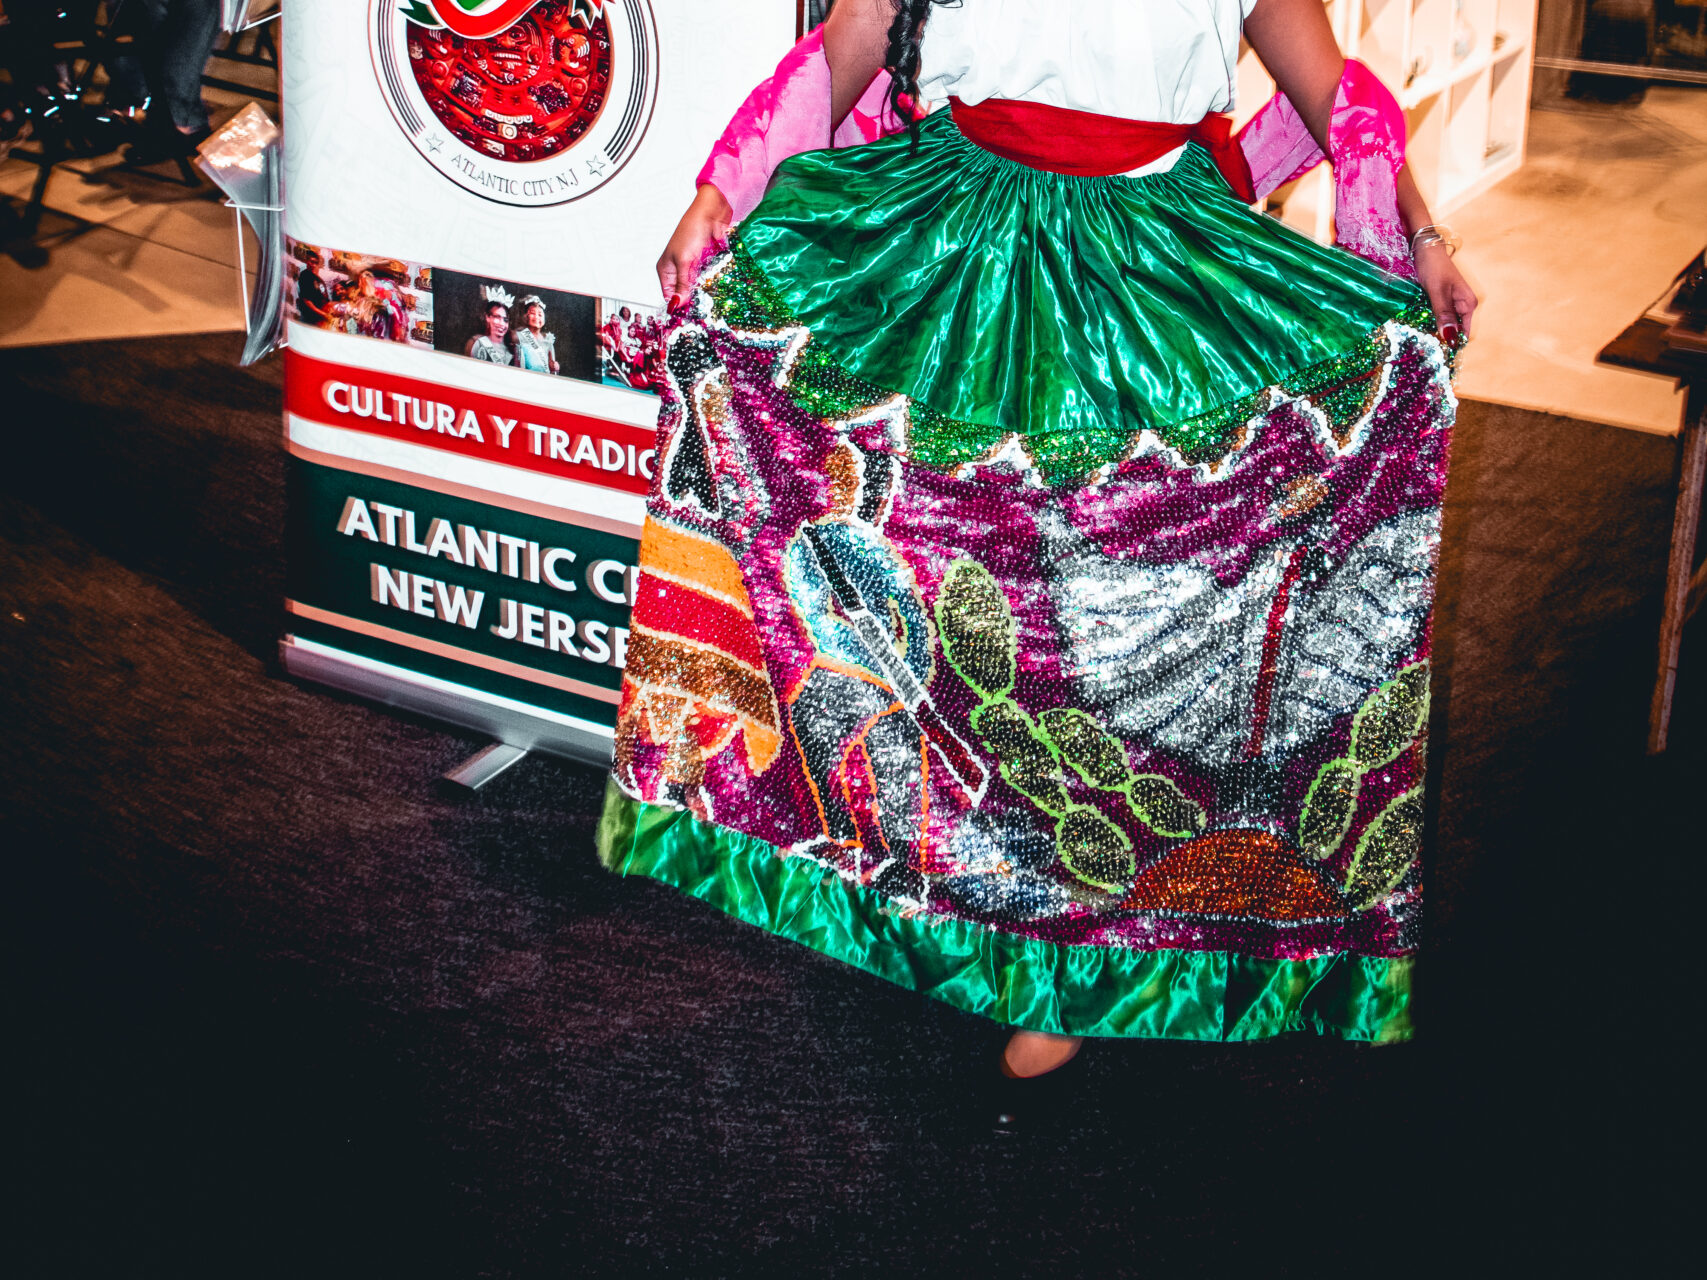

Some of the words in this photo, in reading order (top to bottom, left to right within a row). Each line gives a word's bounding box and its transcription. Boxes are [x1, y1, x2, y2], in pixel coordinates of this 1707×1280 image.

[451, 152, 519, 196] ATLANTIC
[522, 178, 556, 198] CITY
[323, 381, 485, 444] CULTURA
[491, 416, 519, 449] Y
[338, 496, 577, 593] ATLANTIC
[371, 562, 485, 630] NEW
